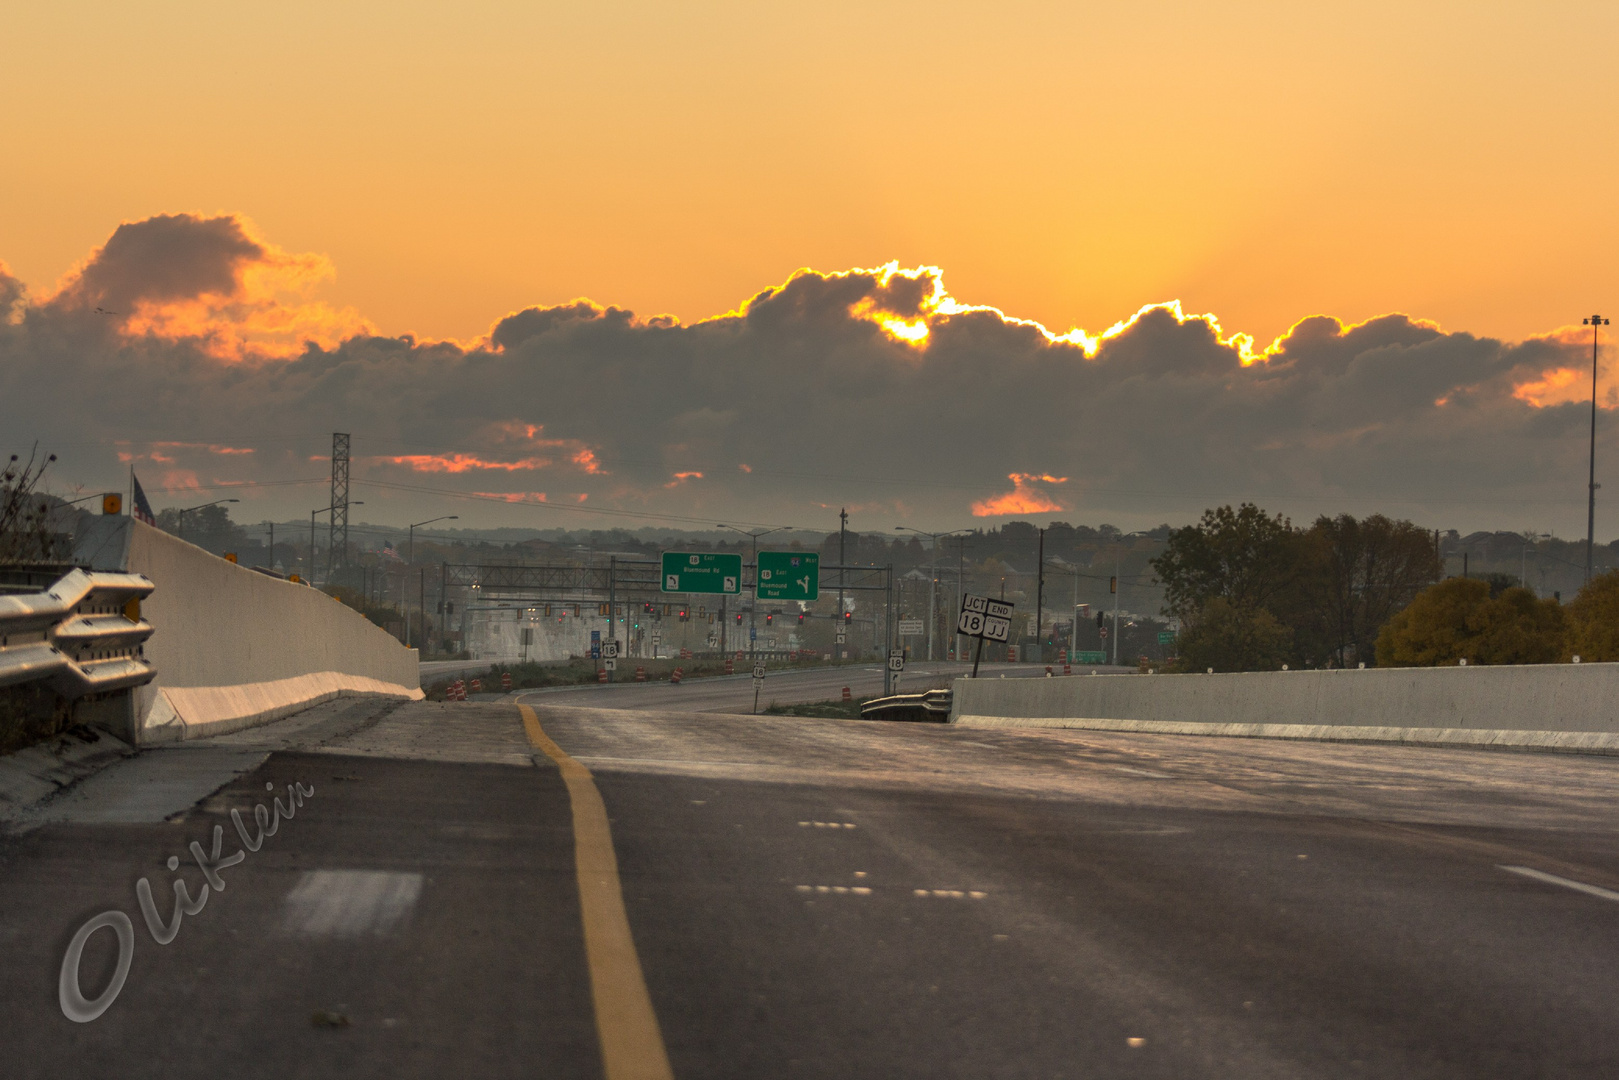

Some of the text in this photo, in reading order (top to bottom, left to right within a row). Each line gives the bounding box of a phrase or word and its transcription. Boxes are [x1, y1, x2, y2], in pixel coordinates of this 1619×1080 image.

[690, 556, 698, 564] 18
[966, 597, 986, 610] JCT
[992, 605, 1009, 615] END
[963, 615, 980, 630] 18
[987, 617, 1008, 626] COUNTY
[988, 625, 1005, 637] JJ
[605, 646, 615, 655] 18
[891, 659, 901, 667] 18
[755, 668, 764, 676] 18
